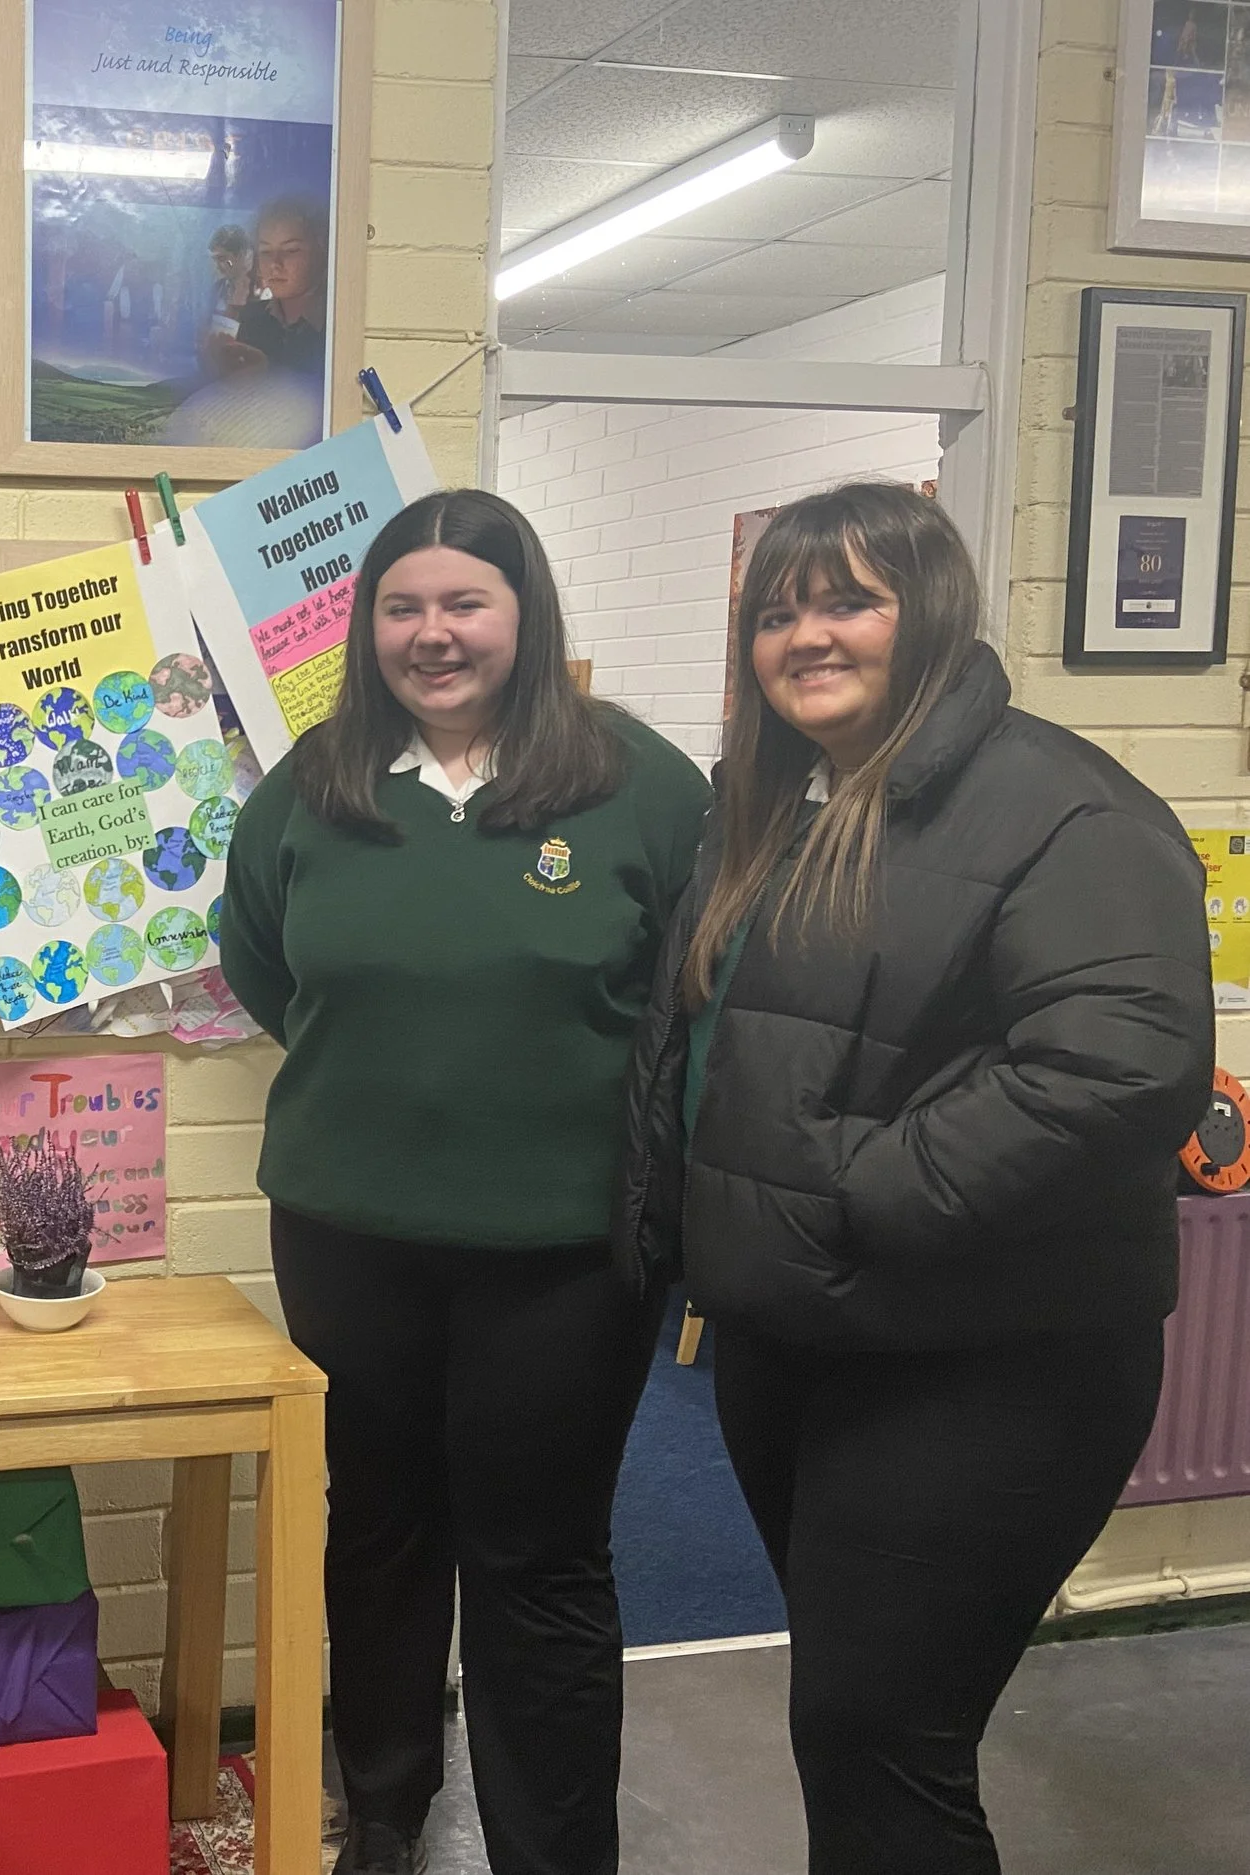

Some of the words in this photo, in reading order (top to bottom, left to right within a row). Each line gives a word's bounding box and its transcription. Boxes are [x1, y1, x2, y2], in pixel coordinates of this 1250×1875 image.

[165, 27, 213, 57] Being
[92, 52, 132, 73] Just
[136, 55, 171, 73] and
[179, 59, 277, 85] Responsible
[257, 470, 339, 524] Walking
[258, 511, 343, 569] Together
[345, 500, 369, 526] in
[300, 552, 352, 593] Hope
[1140, 554, 1161, 572] 80
[31, 573, 119, 615] Together
[90, 611, 122, 634] our
[255, 629, 270, 643] We
[272, 616, 295, 635] must
[296, 605, 311, 621] not
[312, 596, 326, 610] let
[328, 586, 350, 604] hope
[22, 658, 82, 690] World
[275, 681, 294, 695] May
[296, 666, 310, 681] the
[312, 655, 332, 671] Lord
[103, 695, 121, 708] Be
[122, 689, 149, 703] Kind
[39, 806, 47, 820] I
[47, 801, 77, 818] can
[82, 792, 114, 810] care
[119, 784, 142, 800] for
[48, 822, 95, 844] Earth,
[99, 808, 146, 830] God's
[56, 843, 123, 869] creation,
[125, 834, 150, 854] by:
[30, 1073, 160, 1118] Troubles
[124, 1158, 163, 1181] and
